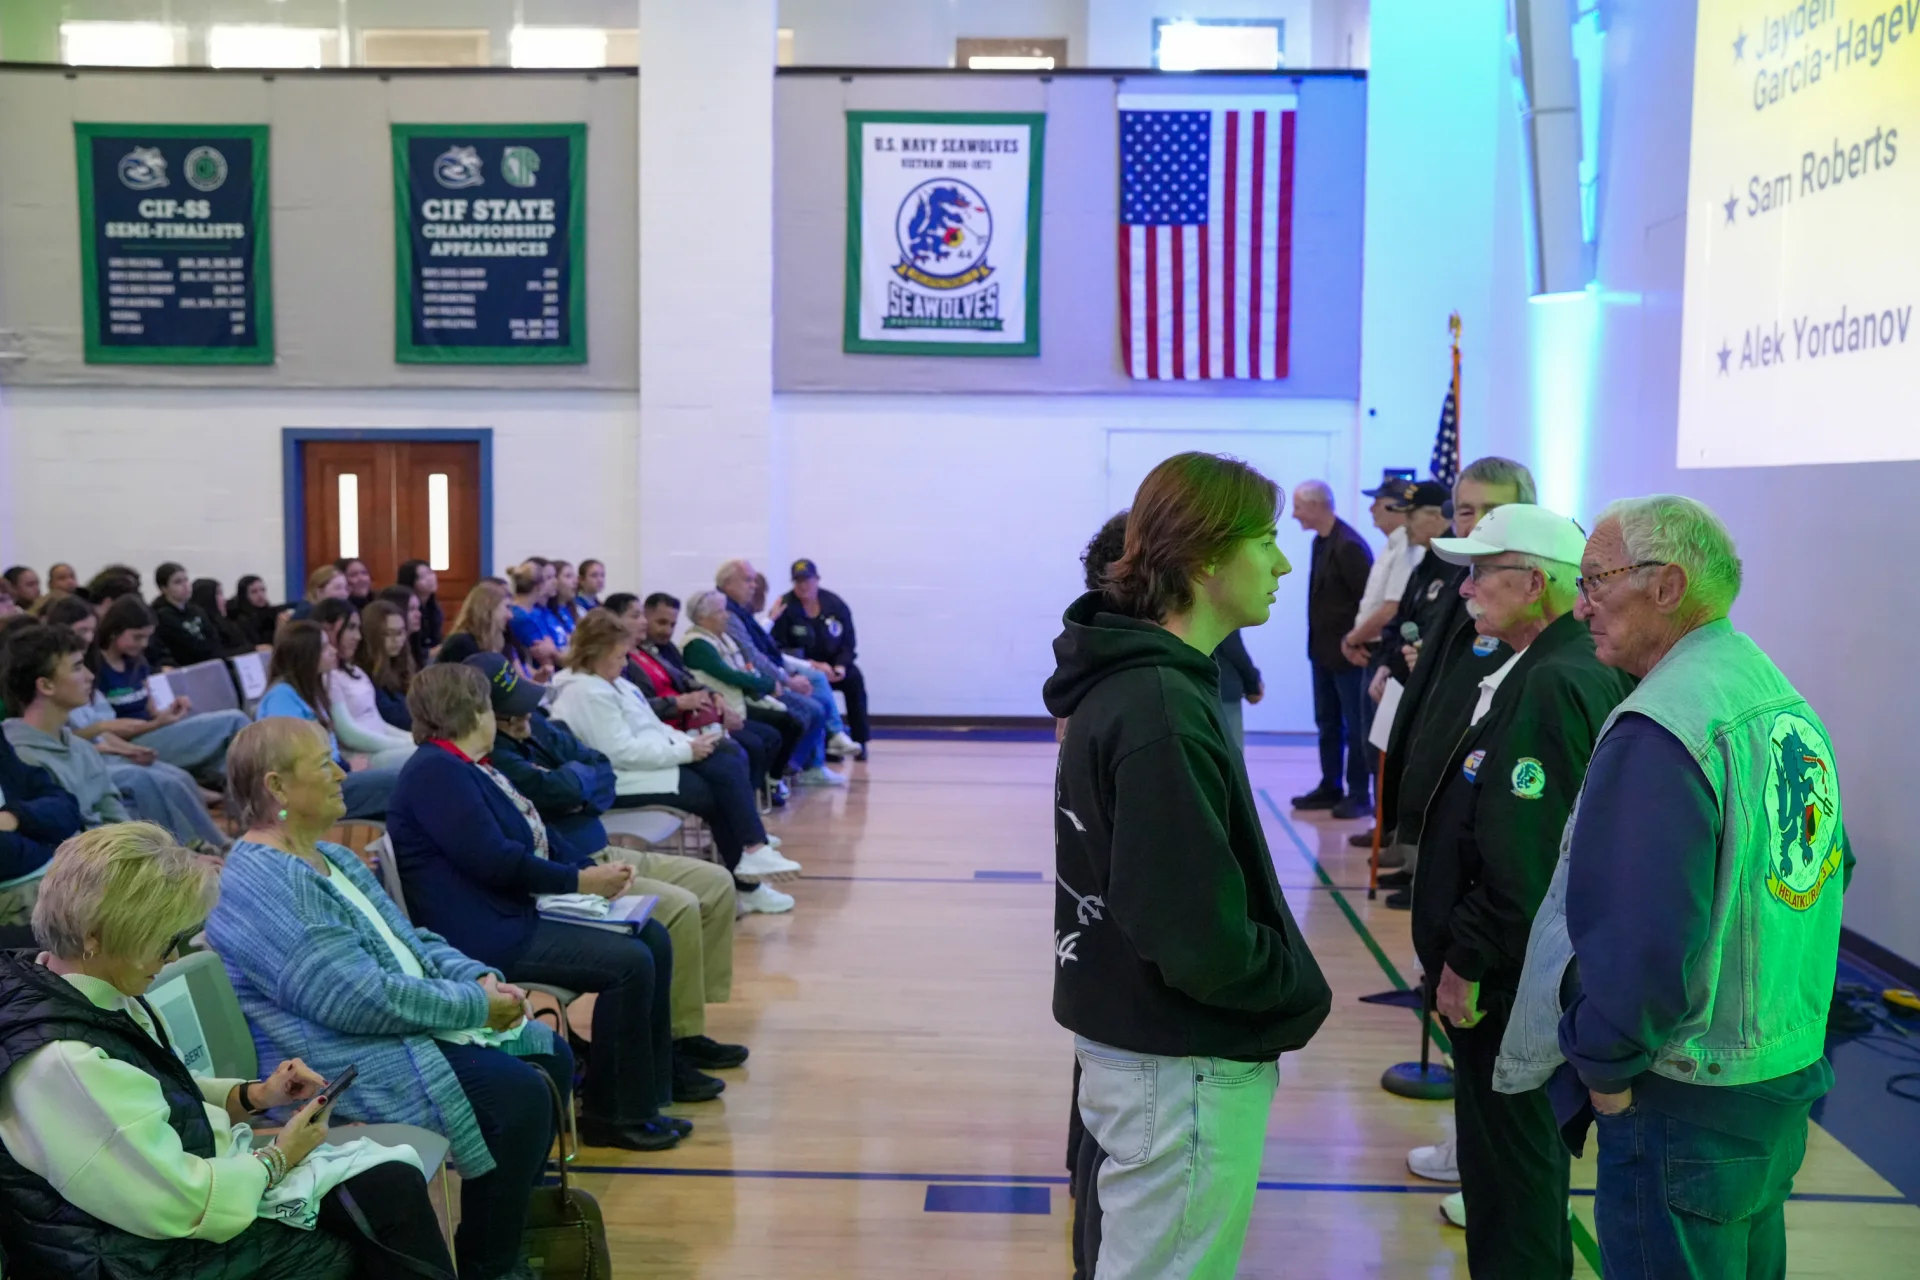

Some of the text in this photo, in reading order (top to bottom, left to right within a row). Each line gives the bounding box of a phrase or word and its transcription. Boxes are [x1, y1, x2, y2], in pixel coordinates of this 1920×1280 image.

[902, 138, 938, 152] NAVY
[941, 138, 1019, 154] SEAWOLVES
[1747, 126, 1898, 218] Sam Roberts
[138, 198, 211, 220] CIF-SS
[421, 199, 556, 221] CIF STATE
[105, 222, 246, 239] SEMI-FINALISTS
[421, 223, 556, 239] CHAMPIONSHIP
[429, 241, 549, 257] APPEARANCES
[888, 281, 999, 319] SEAWOLVES
[1739, 304, 1913, 371] Alek Yordanov
